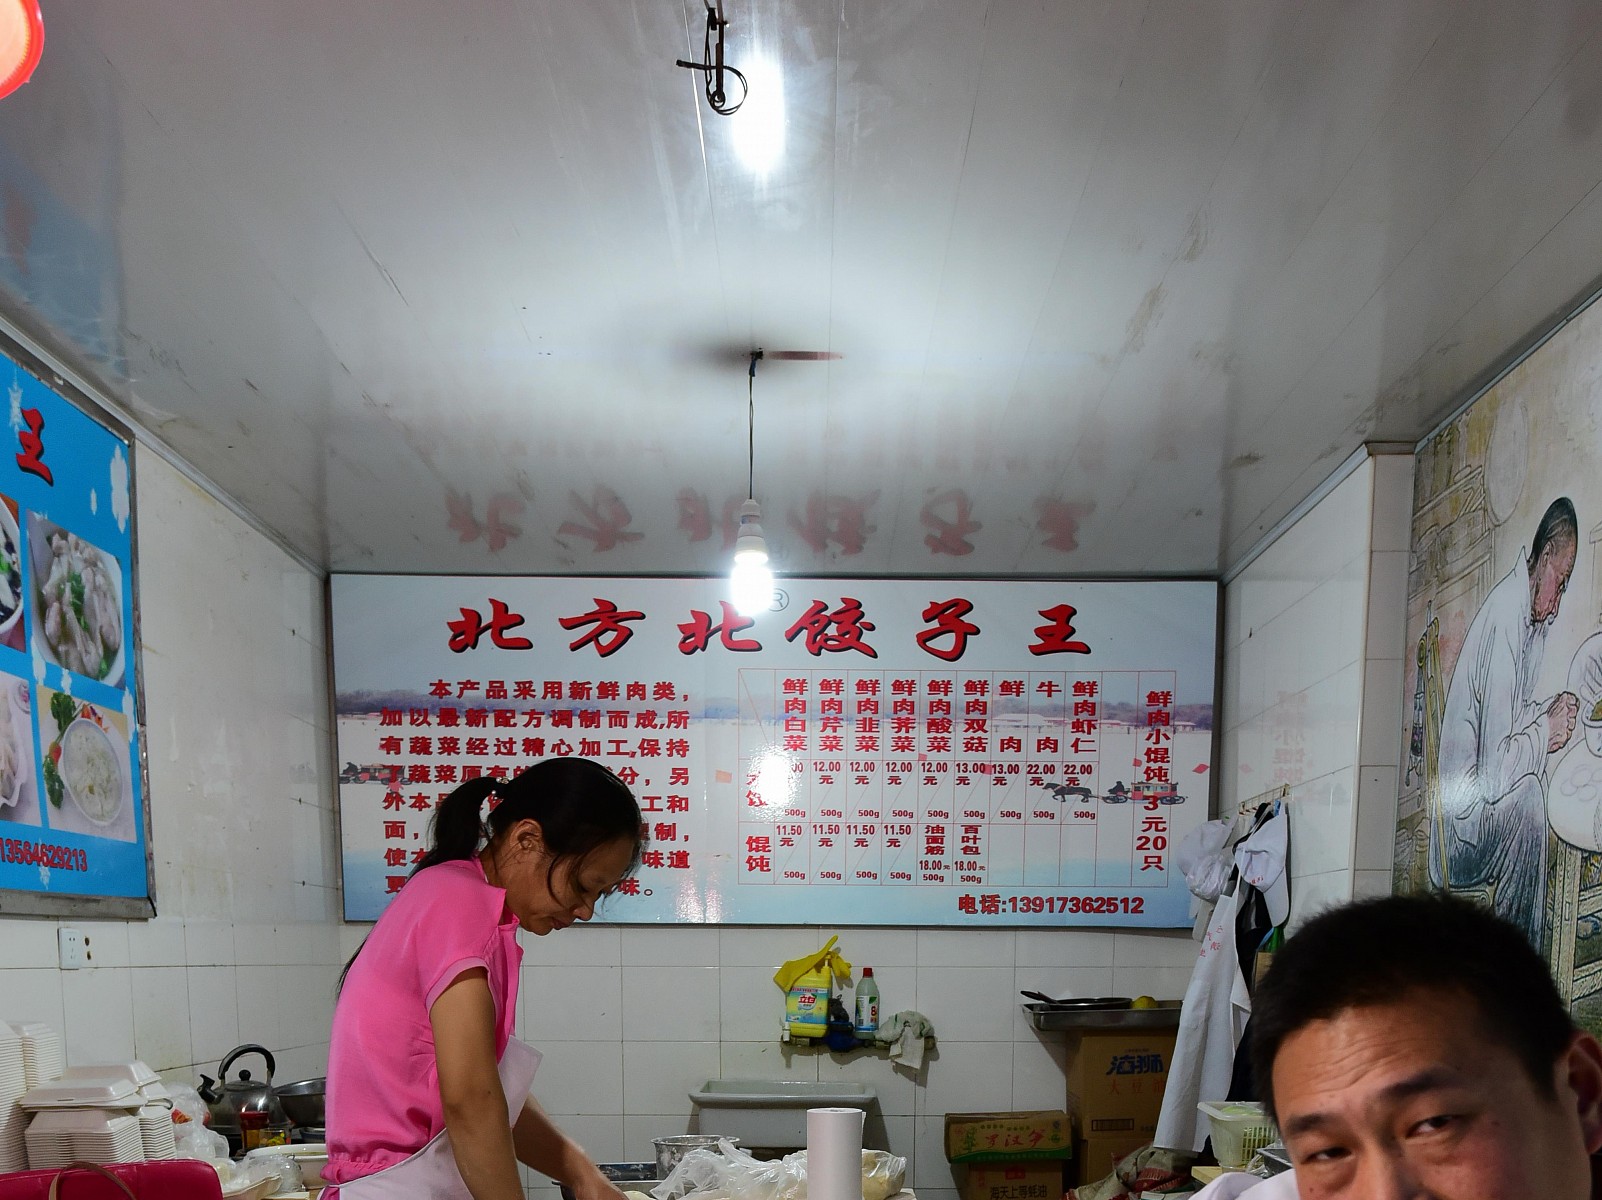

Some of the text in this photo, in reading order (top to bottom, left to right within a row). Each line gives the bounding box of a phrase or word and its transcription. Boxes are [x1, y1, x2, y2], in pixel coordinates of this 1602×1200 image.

[447, 597, 1092, 662] 北方北饺子王
[429, 679, 689, 701] 本产品采用新鲜肉类，
[782, 678, 808, 752] 鲜肉白菜
[818, 678, 845, 752] 鲜肉芹菜
[854, 678, 881, 753] 鲜肉韭菜
[926, 679, 953, 753] 鲜肉酸菜
[962, 679, 989, 753] 鲜肉双菇
[1070, 680, 1099, 754] 鲜肉虾仁
[813, 761, 841, 772] 12.00
[850, 761, 875, 773] 12.00
[885, 762, 912, 773] 12.00
[921, 762, 948, 773] 12.00
[956, 762, 985, 774] 13.00
[991, 763, 1020, 775] 13.00
[1026, 764, 1055, 775] 22.00
[1063, 764, 1092, 775] 22.00
[784, 809, 806, 817] 500g
[820, 809, 842, 818] 500g
[858, 809, 880, 818] 500g
[892, 810, 913, 819] 500g
[927, 810, 949, 819] 500g
[963, 810, 985, 819] 500g
[1000, 810, 1022, 819] 500g
[1033, 810, 1055, 819] 500g
[1074, 811, 1096, 820] 500g
[776, 825, 802, 836] 11.50
[813, 824, 840, 835] 11.50
[847, 824, 875, 835] 11.50
[884, 825, 912, 836] 11.50
[745, 835, 771, 872] 馄饨
[784, 871, 806, 880] 500g
[820, 871, 842, 880] 500g
[856, 871, 878, 880] 500g
[890, 872, 912, 881] 500g
[922, 873, 945, 882] 500g
[960, 875, 982, 884] 500g
